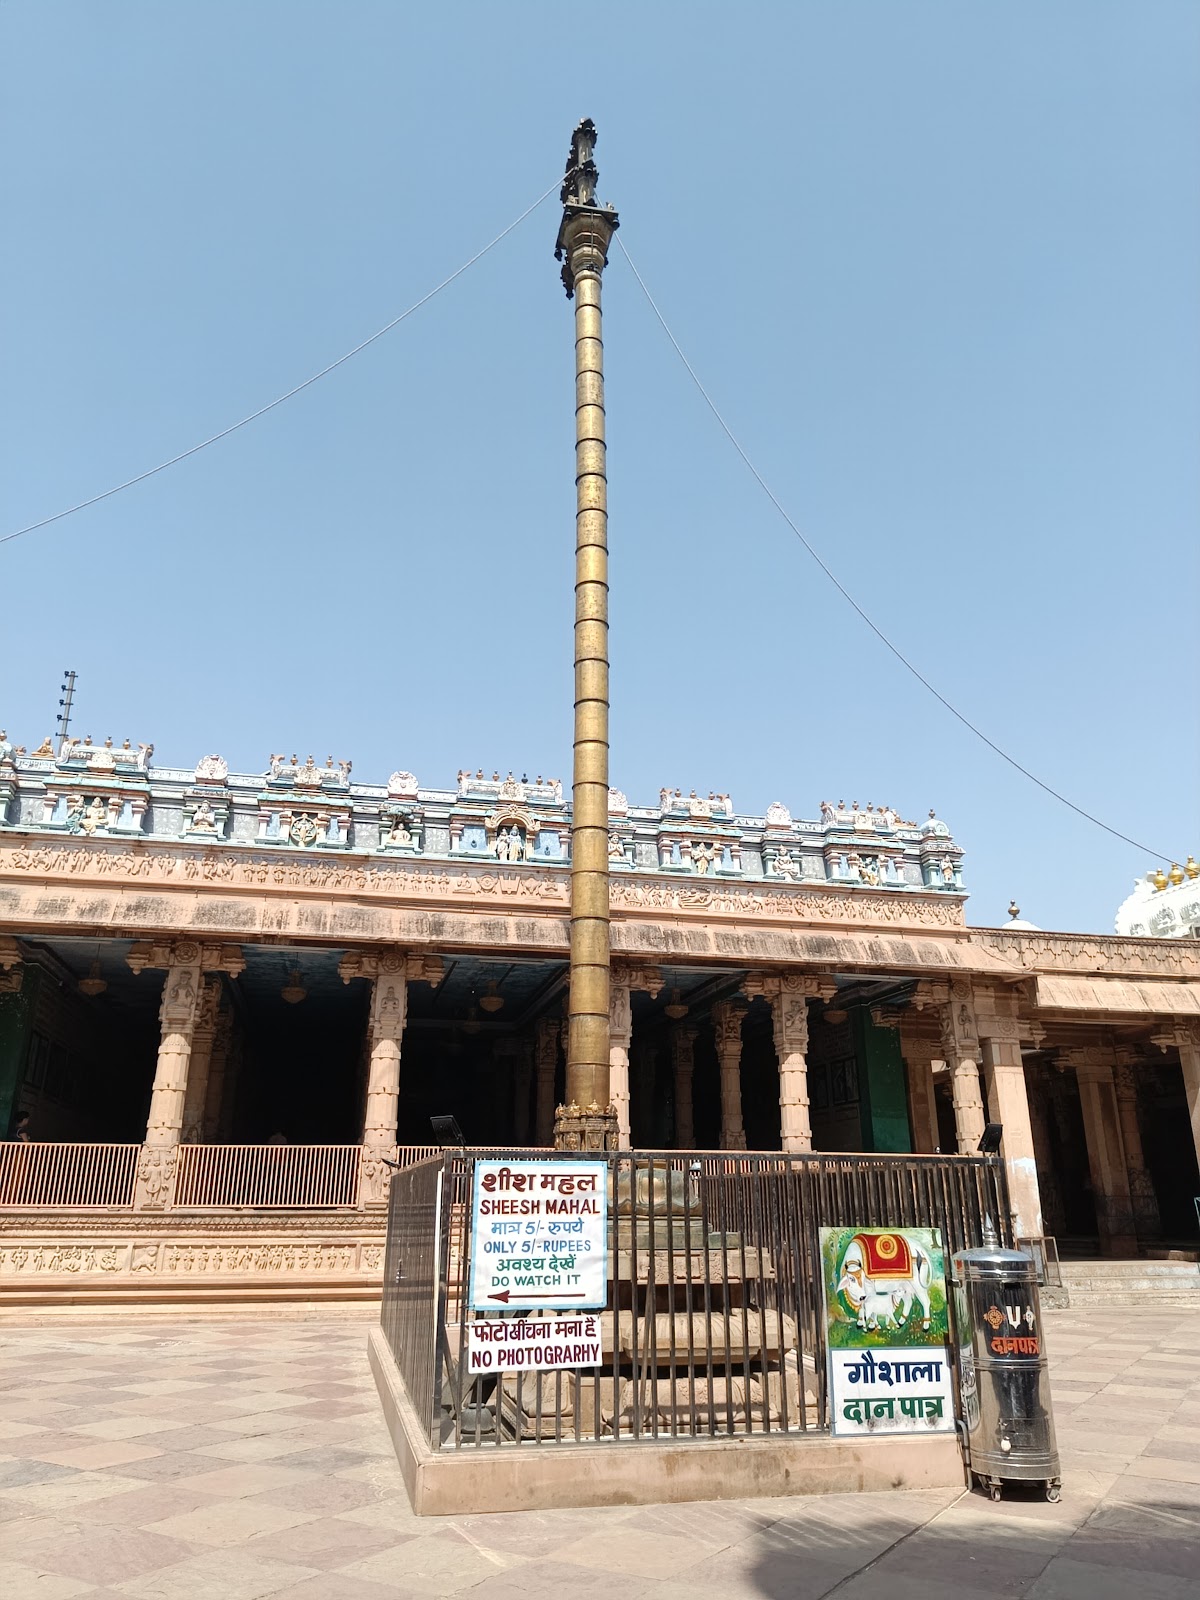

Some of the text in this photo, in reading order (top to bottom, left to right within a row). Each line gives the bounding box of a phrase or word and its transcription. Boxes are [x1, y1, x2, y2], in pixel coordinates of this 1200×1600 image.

[481, 1167, 598, 1195] शीश महल
[480, 1198, 600, 1215] SHEESH MAHAL
[491, 1221, 523, 1235] मात्र
[548, 1217, 584, 1235] रुपये
[483, 1241, 517, 1254] ONLY
[496, 1254, 577, 1273] अवश्य देखें
[491, 1274, 581, 1287] DO WATCH IT
[554, 1320, 583, 1338] मना
[585, 1316, 597, 1337] है
[471, 1350, 492, 1368] NO
[843, 1350, 943, 1387] गौशाला
